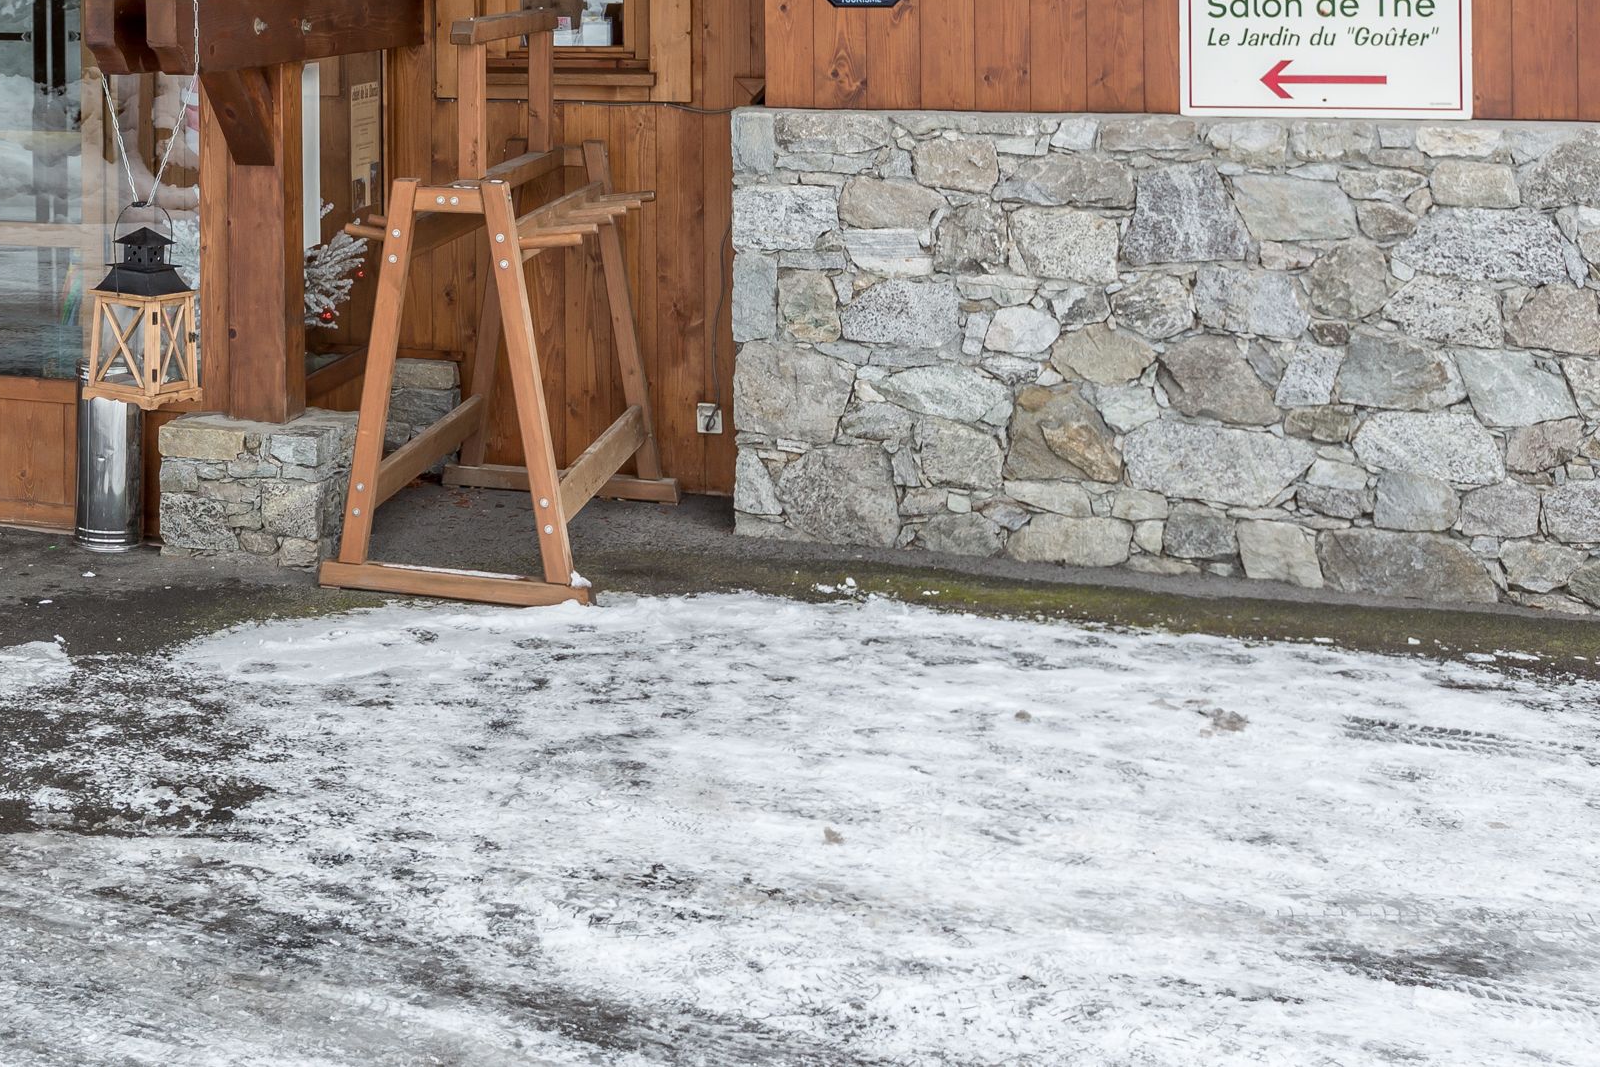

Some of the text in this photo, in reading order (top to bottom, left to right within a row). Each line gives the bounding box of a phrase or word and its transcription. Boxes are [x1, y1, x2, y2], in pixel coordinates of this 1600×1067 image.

[1206, 26, 1440, 47] Le Jardin du "Goûter"
